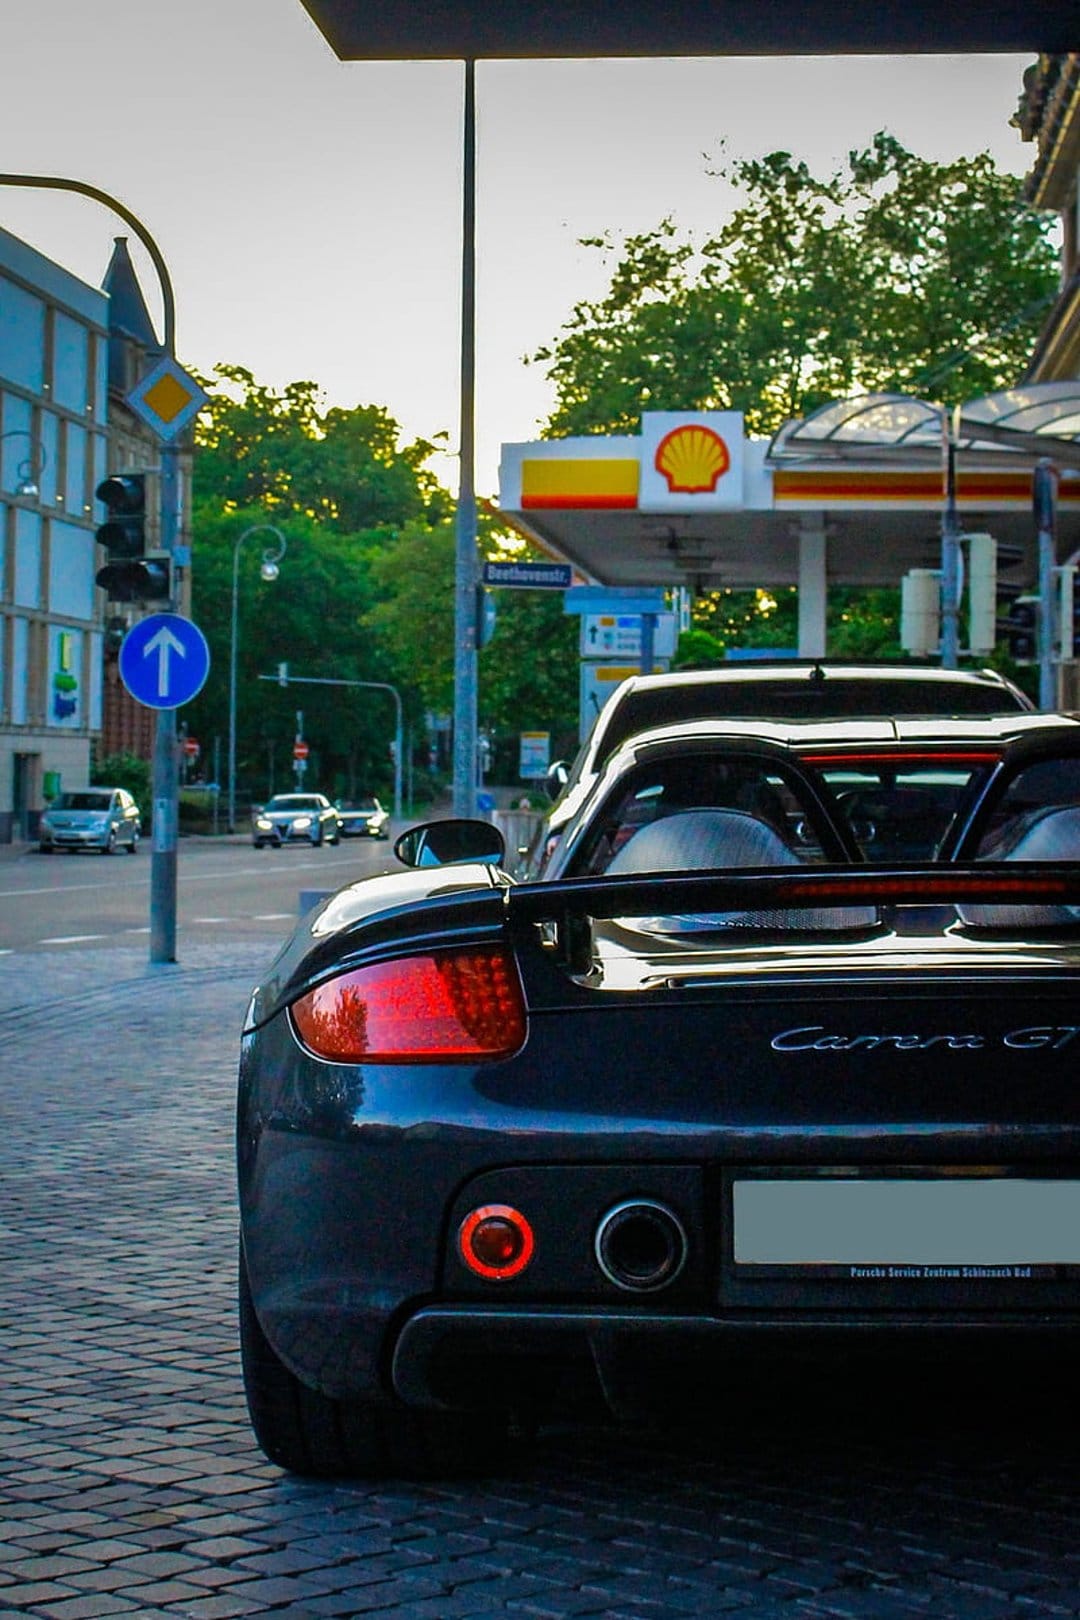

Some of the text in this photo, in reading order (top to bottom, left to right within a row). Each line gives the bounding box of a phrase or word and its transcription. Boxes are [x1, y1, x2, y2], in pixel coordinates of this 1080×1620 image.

[771, 1026, 1080, 1051] Carrera GT
[850, 1266, 885, 1278] Porsche
[888, 1266, 921, 1278] Service
[923, 1266, 960, 1278] Zentrum
[1014, 1266, 1032, 1278] Bad
